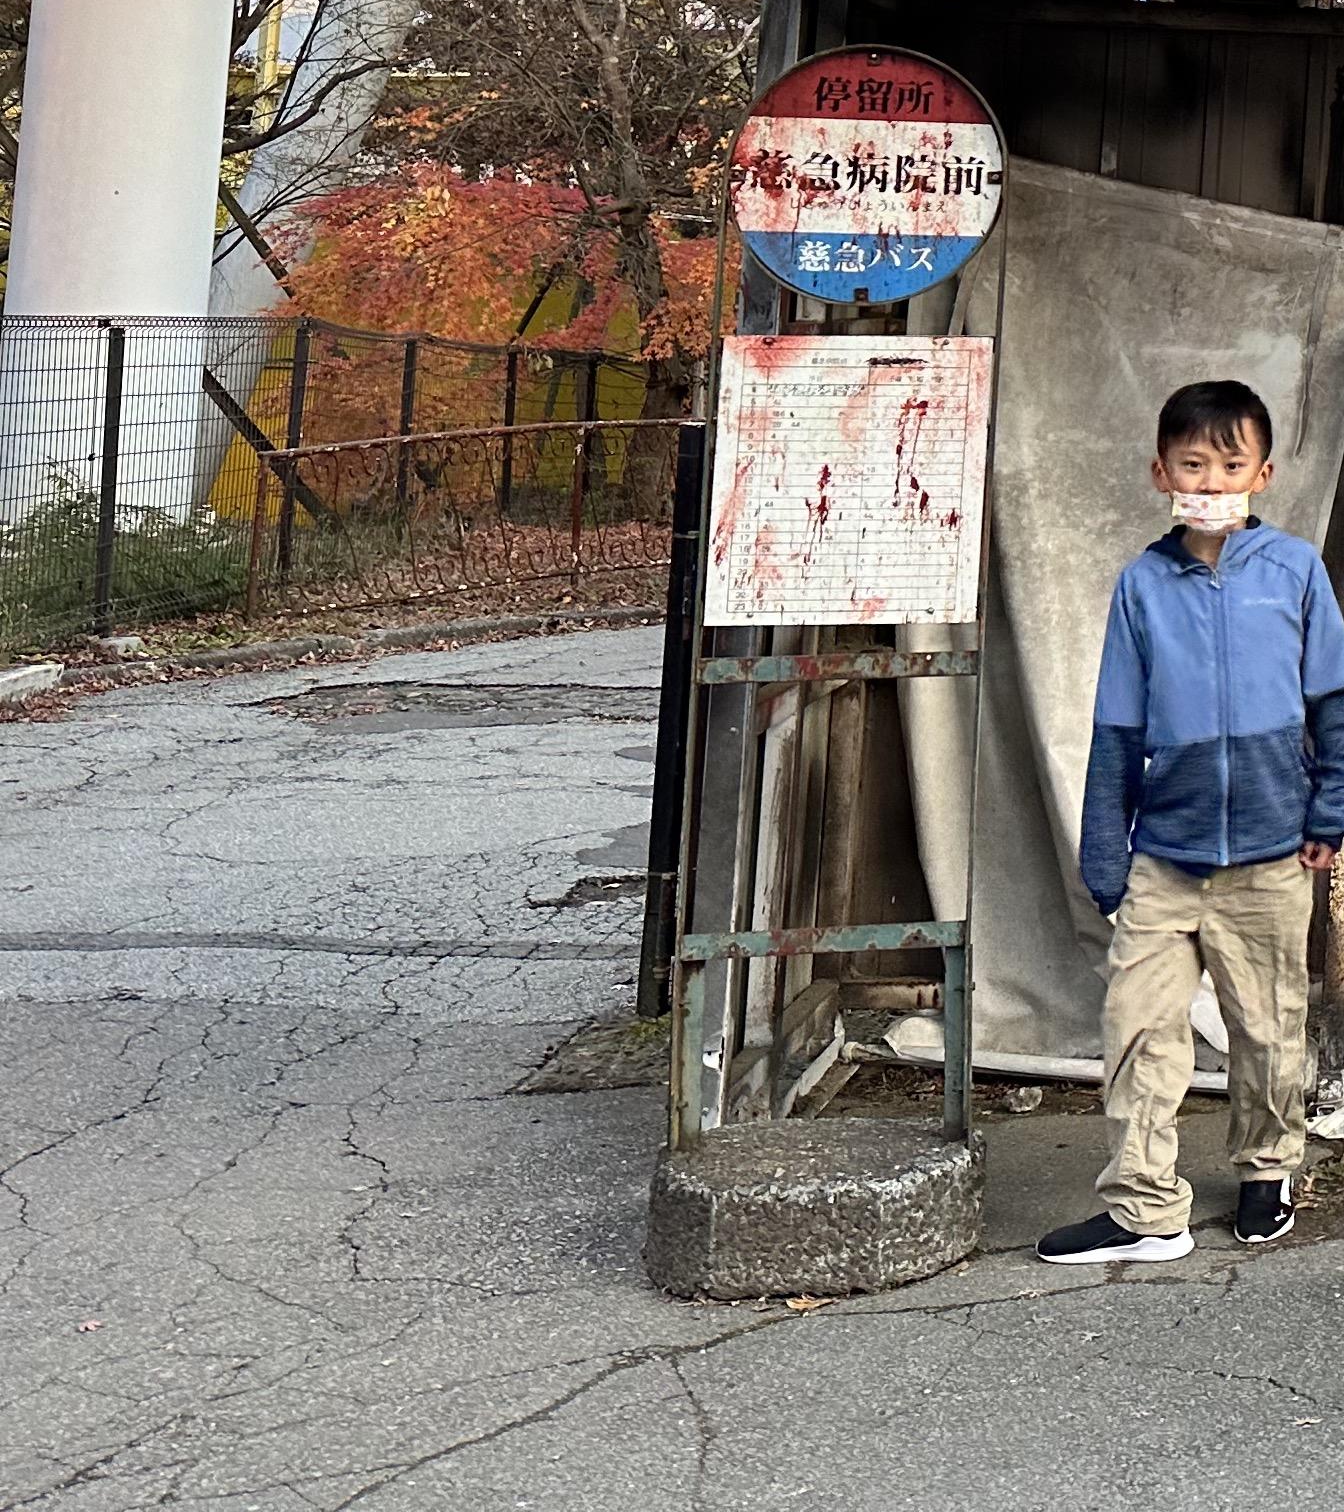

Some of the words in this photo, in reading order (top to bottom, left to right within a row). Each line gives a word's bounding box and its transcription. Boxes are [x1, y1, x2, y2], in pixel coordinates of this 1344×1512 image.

[814, 76, 936, 115] 停留所
[750, 149, 986, 196] 慈急病院前
[797, 240, 934, 272] 慈急バス
